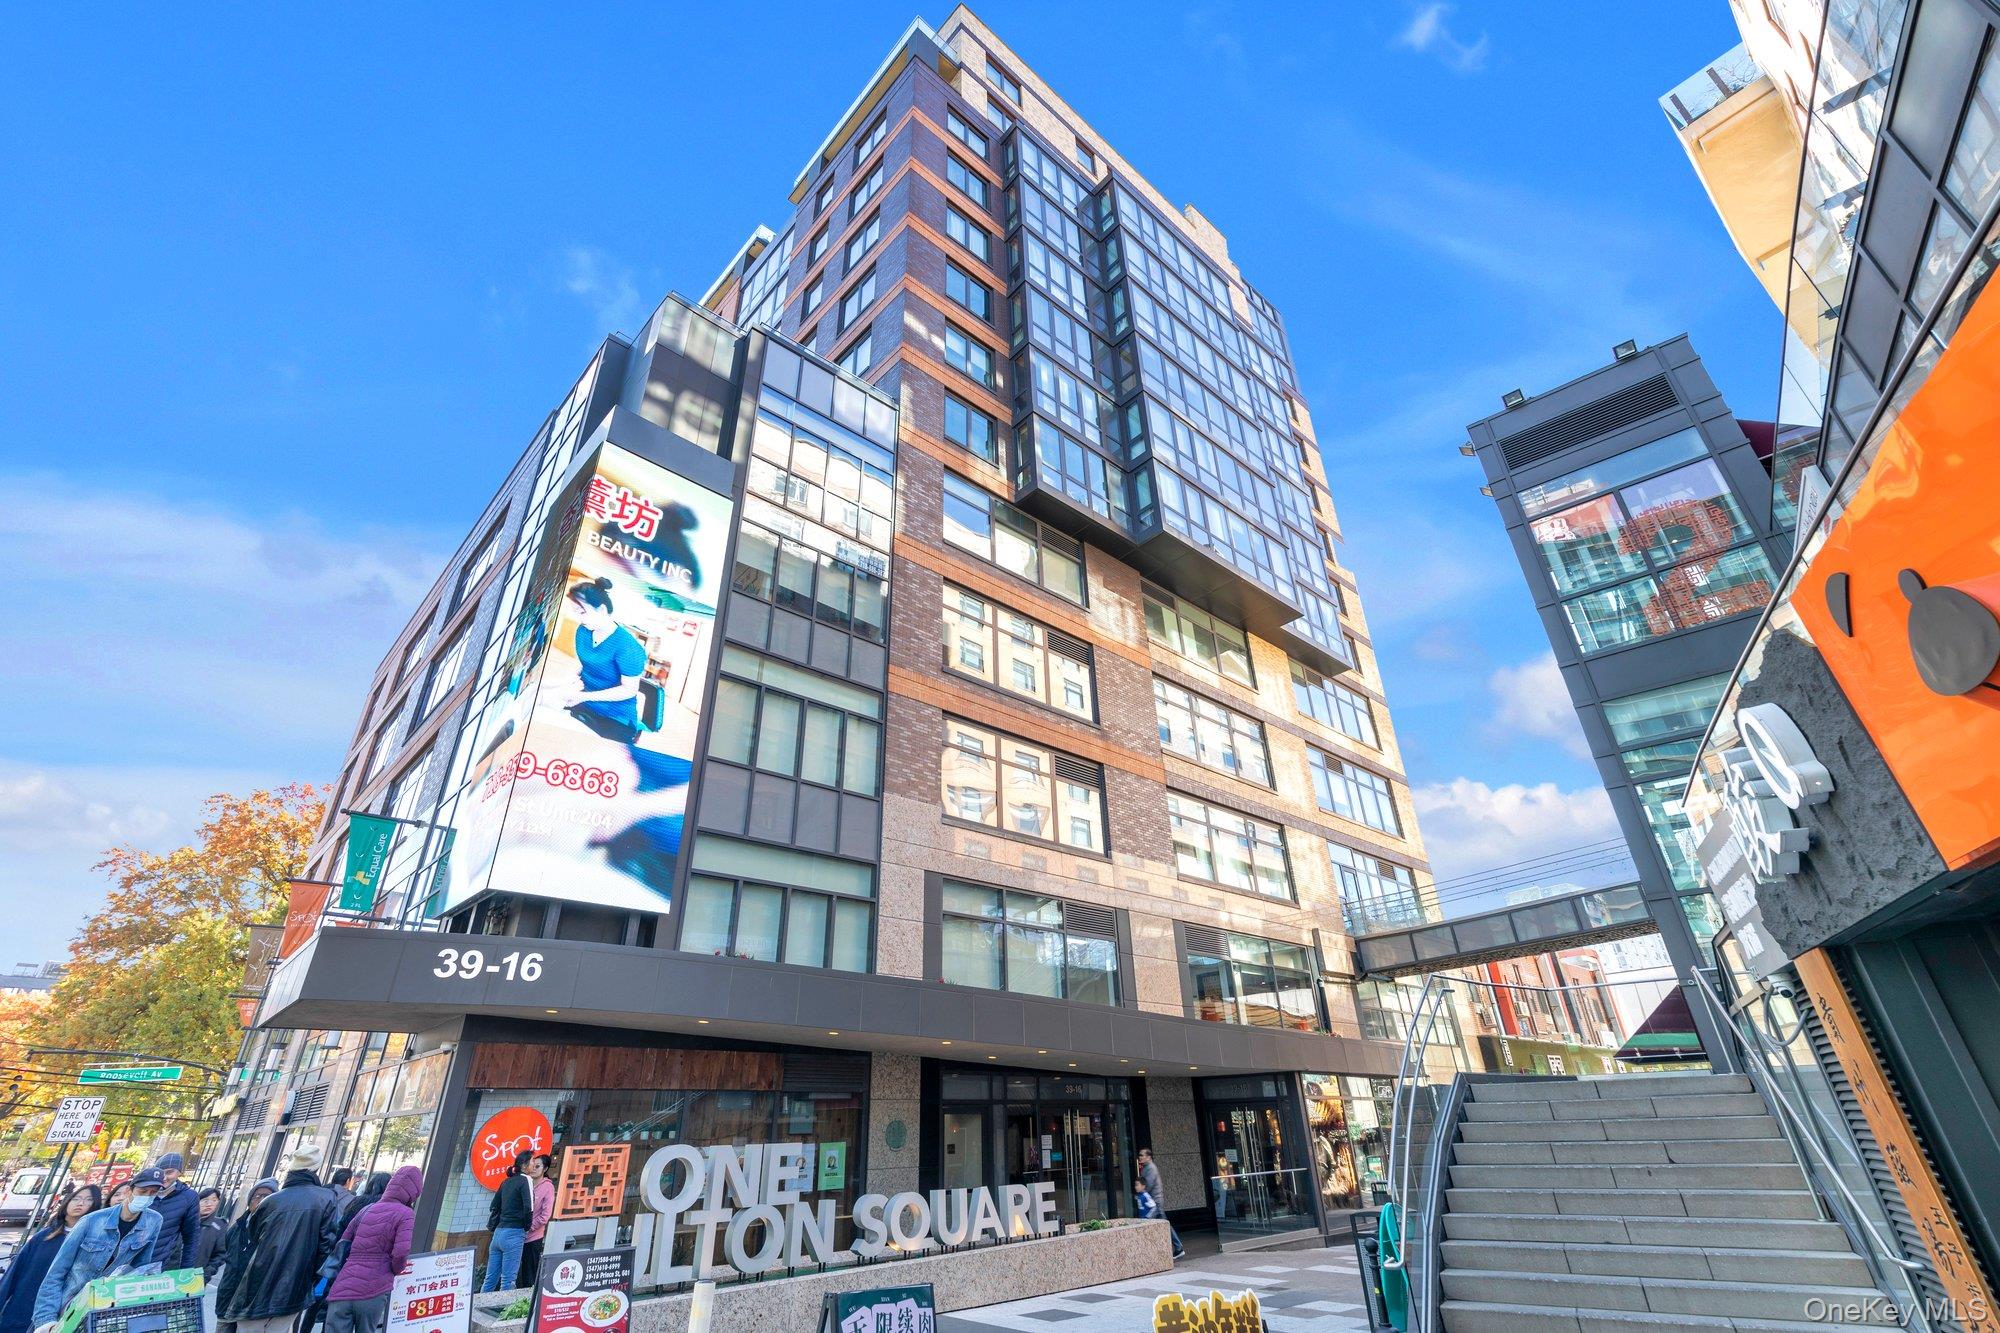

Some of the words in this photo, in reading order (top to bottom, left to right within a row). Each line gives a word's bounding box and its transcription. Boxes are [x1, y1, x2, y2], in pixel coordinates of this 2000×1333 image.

[587, 531, 661, 569] BEAUTY
[661, 560, 692, 583] INC
[373, 833, 388, 853] Care
[366, 853, 381, 878] Equal
[433, 948, 544, 982] 39-16
[99, 1070, 147, 1080] Roosevelt
[150, 1070, 162, 1078] Av
[62, 1099, 101, 1111] STOP
[58, 1112, 80, 1120] HERE
[63, 1121, 83, 1129] RED
[50, 1130, 87, 1139] SIGNAL
[482, 1126, 543, 1161] Spot
[640, 1142, 803, 1215] ONE
[850, 1181, 1059, 1257] SQUARE
[140, 1280, 171, 1292] BANANAS
[406, 1278, 459, 1295] 京门会员日
